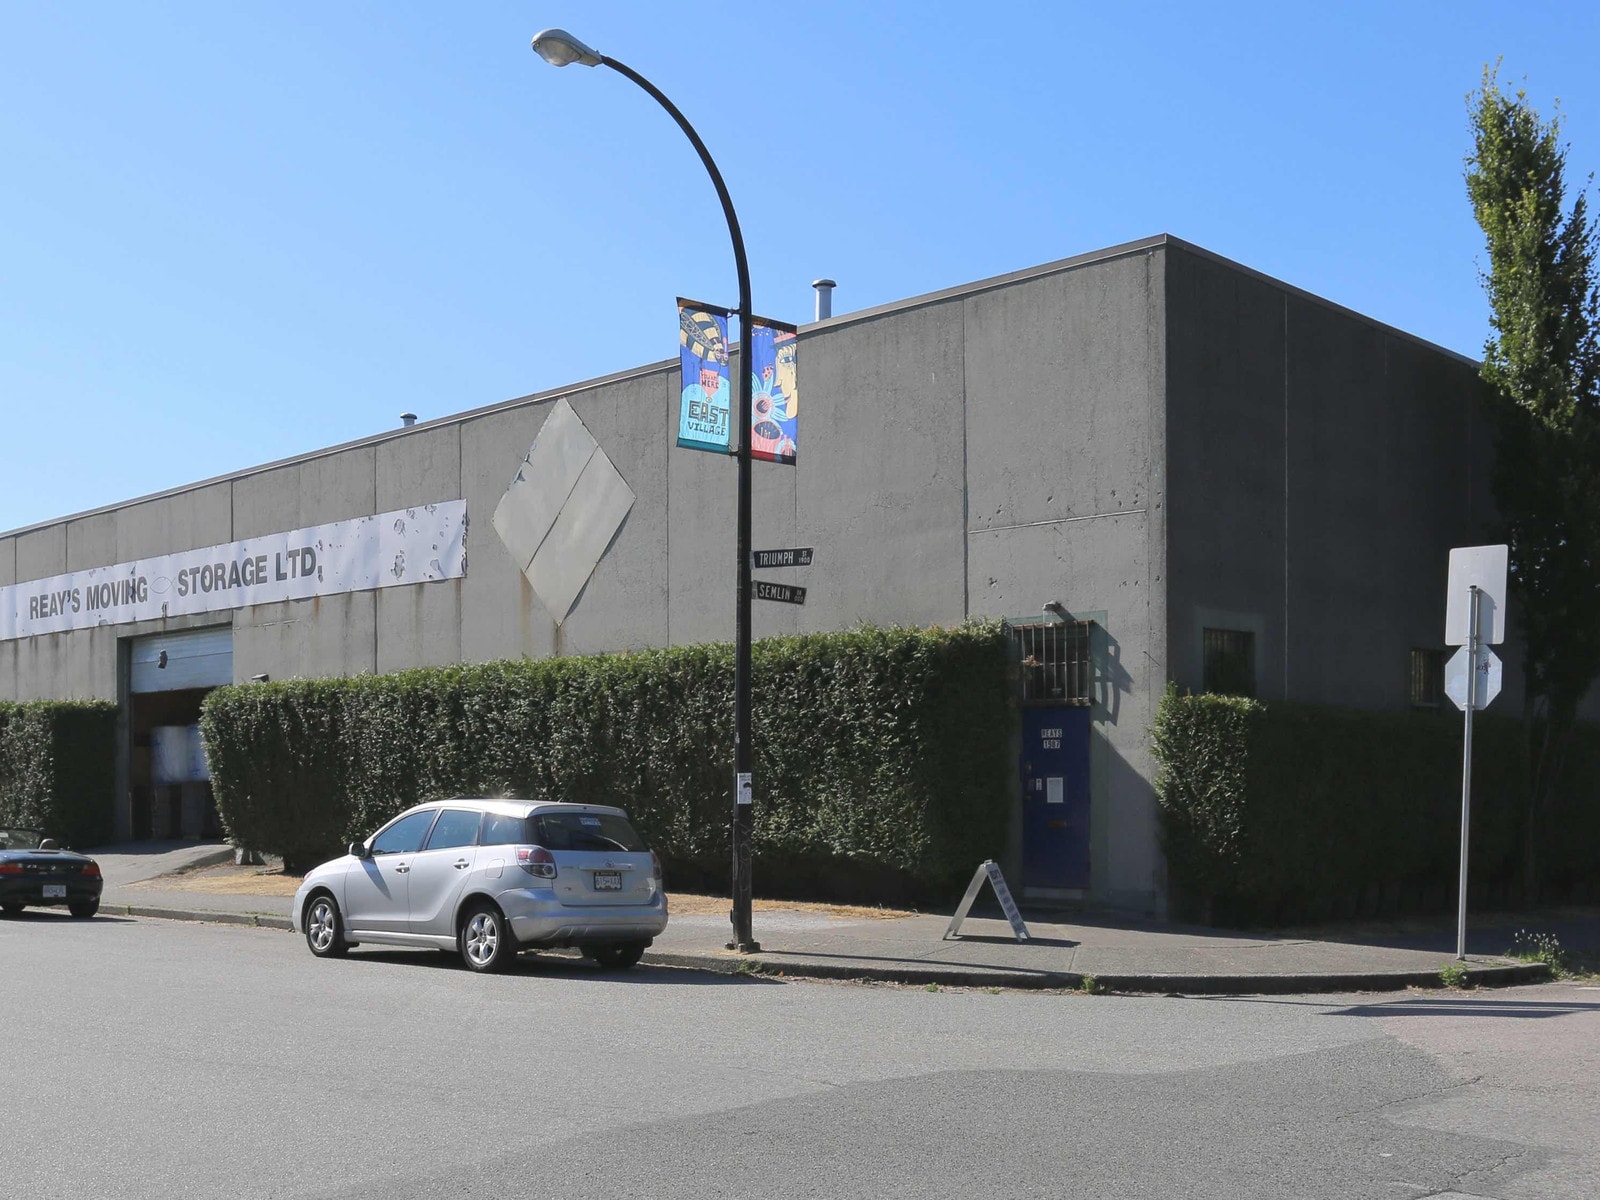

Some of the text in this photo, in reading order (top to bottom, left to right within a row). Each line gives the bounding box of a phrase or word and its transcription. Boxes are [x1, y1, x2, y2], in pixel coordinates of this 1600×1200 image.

[688, 400, 728, 427] EAST
[688, 421, 726, 436] VILLAGE
[760, 551, 794, 566] TRIUMPH
[29, 589, 81, 620] REAY'S
[86, 576, 148, 611] MOVING
[178, 555, 268, 597] STORAGE
[759, 584, 790, 600] SEMLIN
